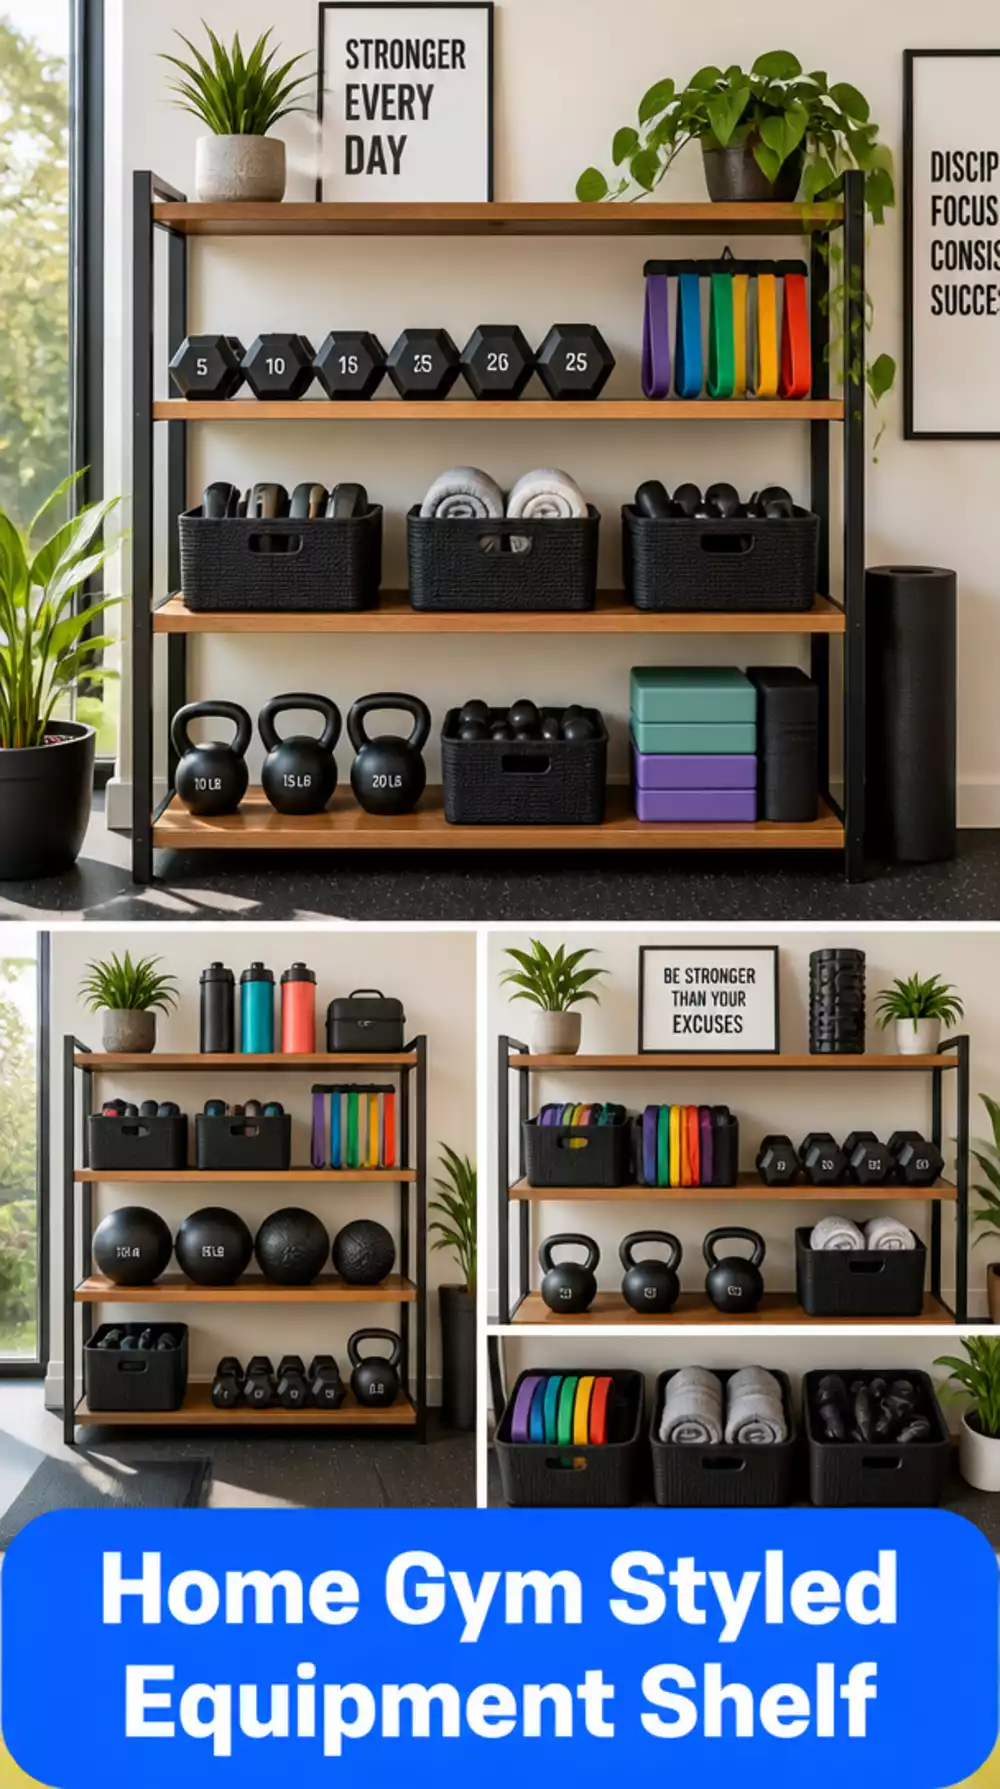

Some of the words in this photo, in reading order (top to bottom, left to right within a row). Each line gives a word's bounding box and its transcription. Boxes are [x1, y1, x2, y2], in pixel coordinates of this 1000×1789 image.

[346, 39, 466, 70] STRONGER
[346, 84, 435, 121] EVERY
[345, 135, 408, 176] DAY
[931, 151, 1000, 183] DISCIP
[931, 195, 999, 227] FOCUS
[931, 284, 1000, 316] SUCCE
[196, 358, 208, 376] 5
[265, 357, 285, 375] 10
[565, 352, 588, 372] 25
[372, 774, 387, 788] 20
[664, 967, 681, 985] BE
[684, 967, 756, 985] STRONGER
[671, 989, 707, 1007] THAN
[710, 989, 746, 1007] YOUR
[672, 1013, 744, 1034] EXCUSES
